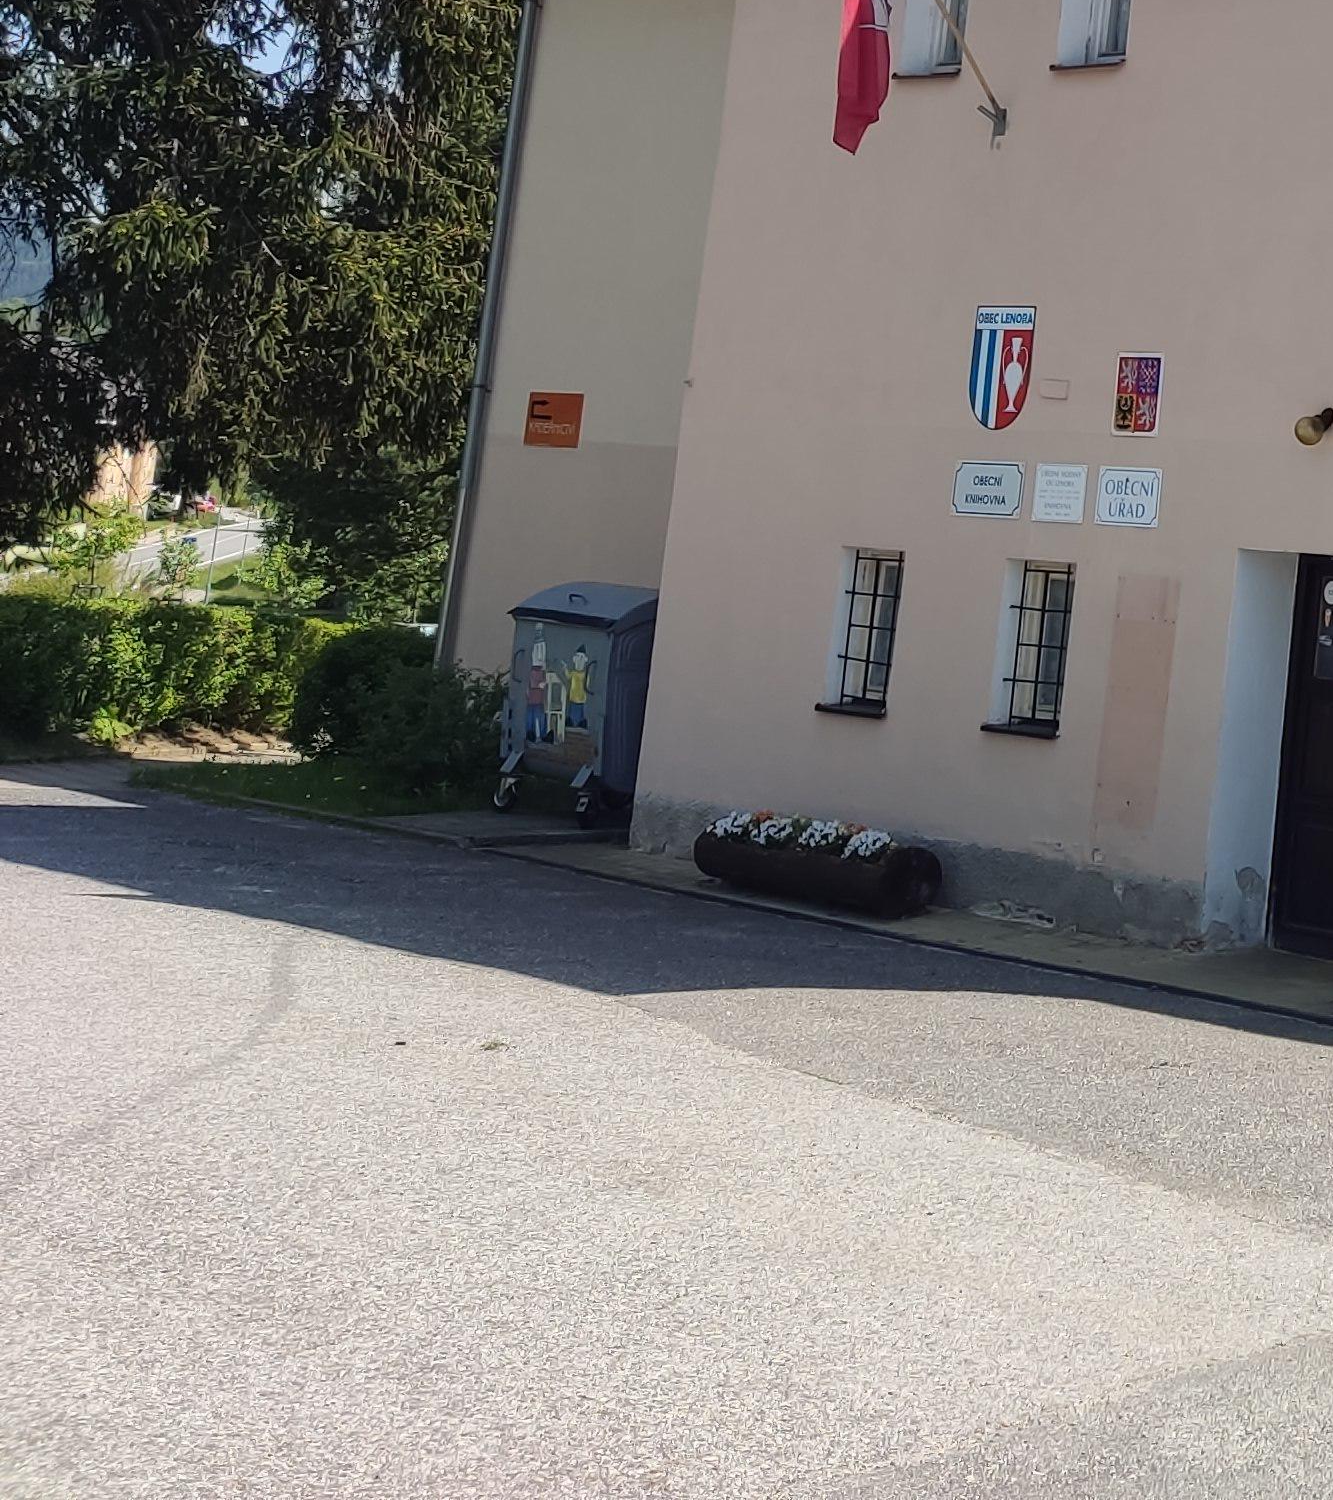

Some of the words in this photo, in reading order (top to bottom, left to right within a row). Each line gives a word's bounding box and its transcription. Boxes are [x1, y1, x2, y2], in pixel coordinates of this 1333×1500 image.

[978, 312, 999, 324] OBEC
[1000, 312, 1033, 325] LENORA
[973, 474, 1004, 487] OBECNÍ
[964, 493, 1006, 505] KNIHOVNA
[1108, 497, 1145, 519] ÚŘAD
